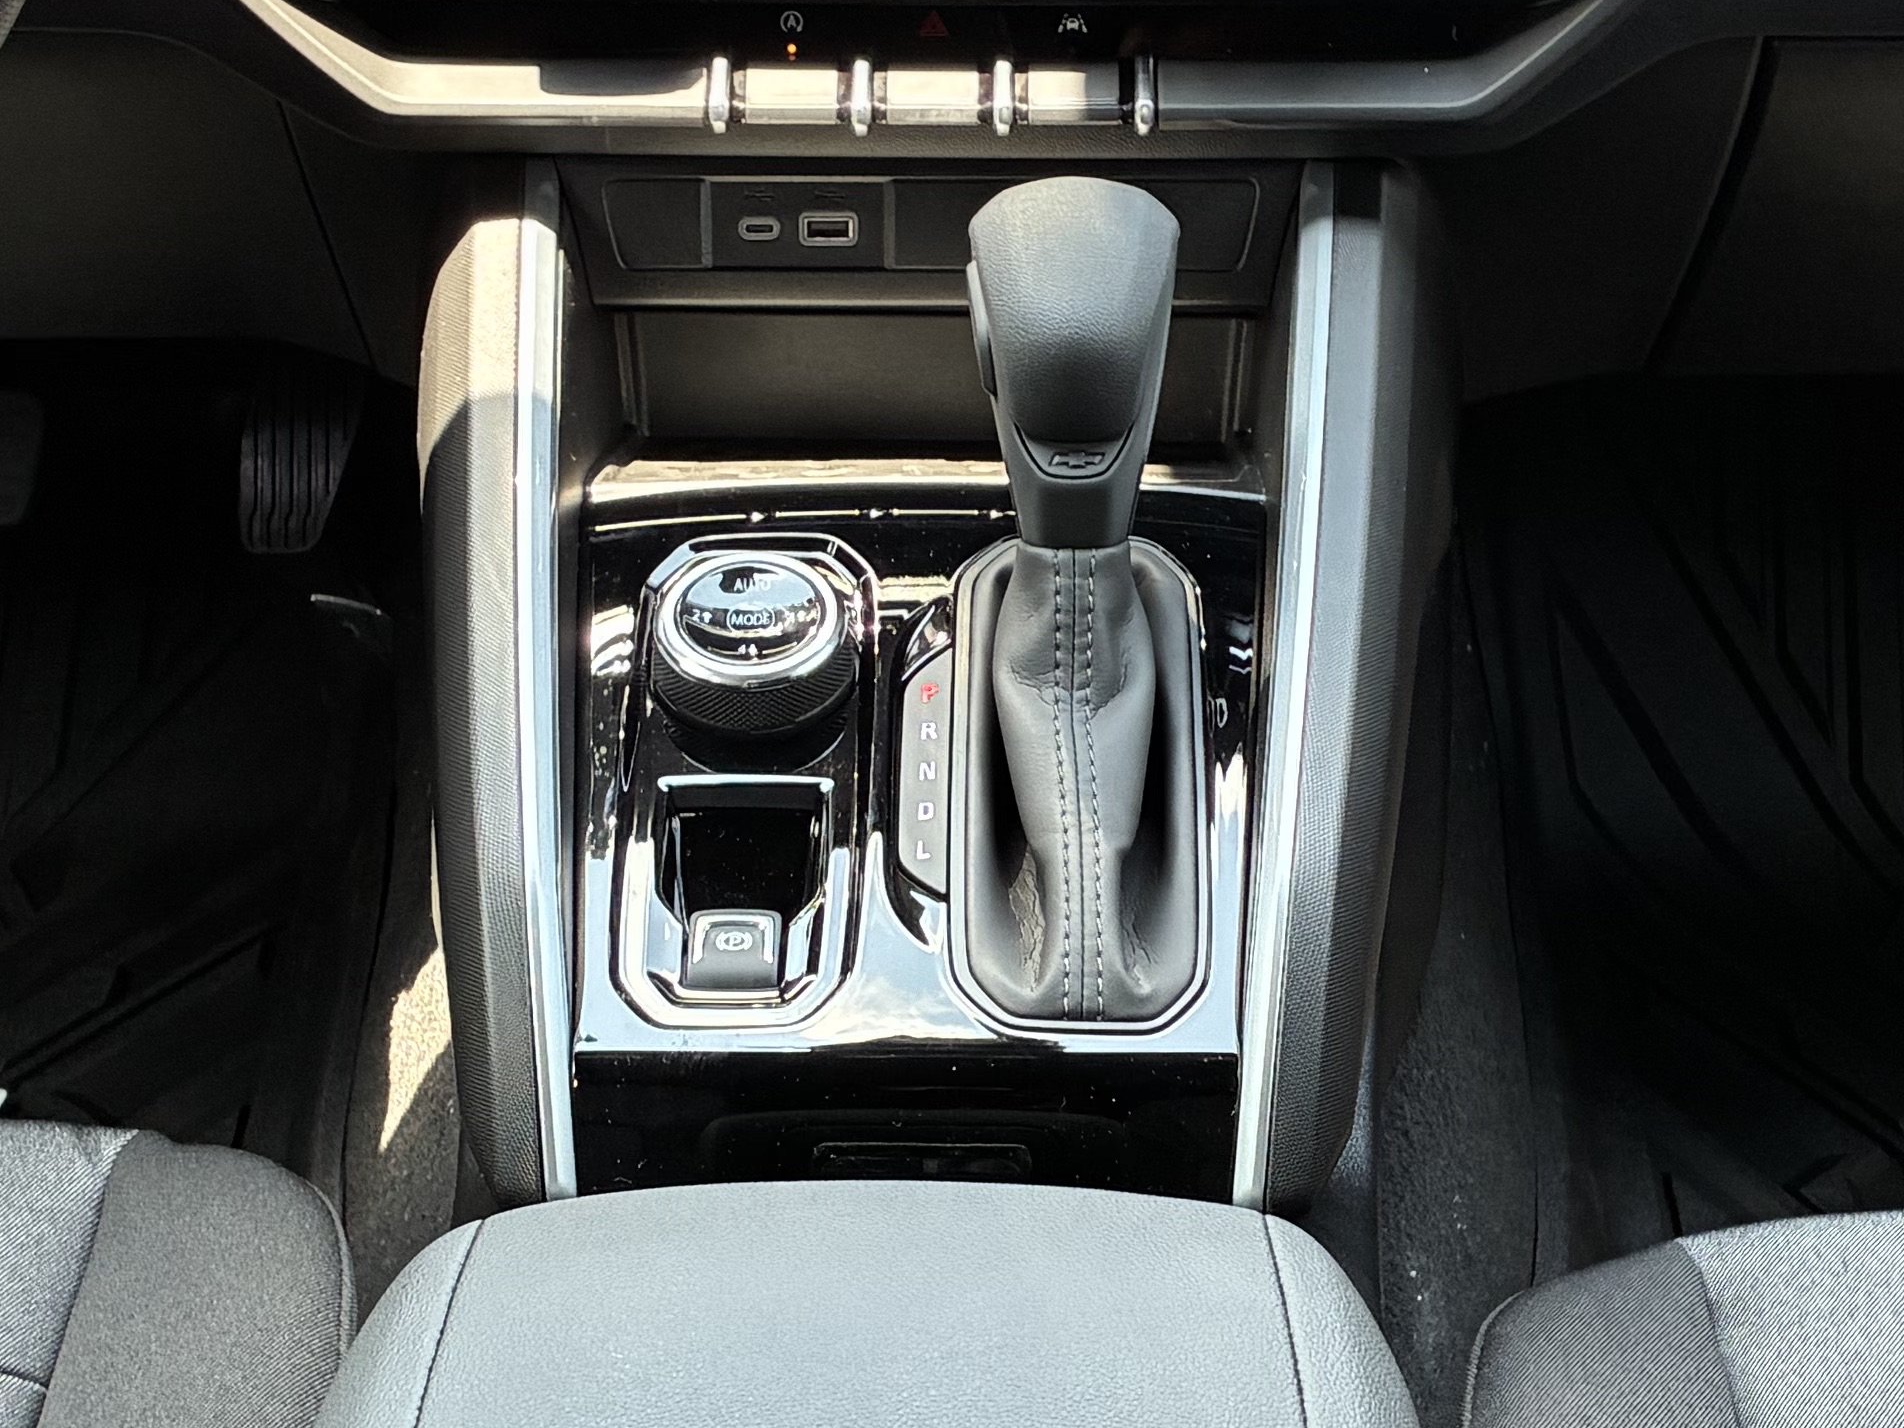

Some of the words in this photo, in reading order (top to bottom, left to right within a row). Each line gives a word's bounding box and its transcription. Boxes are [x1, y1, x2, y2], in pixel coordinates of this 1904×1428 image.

[734, 578, 771, 592] AUTO
[730, 612, 772, 626] MODE
[920, 682, 940, 703] P
[920, 722, 938, 740] R
[919, 761, 936, 781] N
[917, 802, 934, 821] D
[916, 840, 931, 860] L
